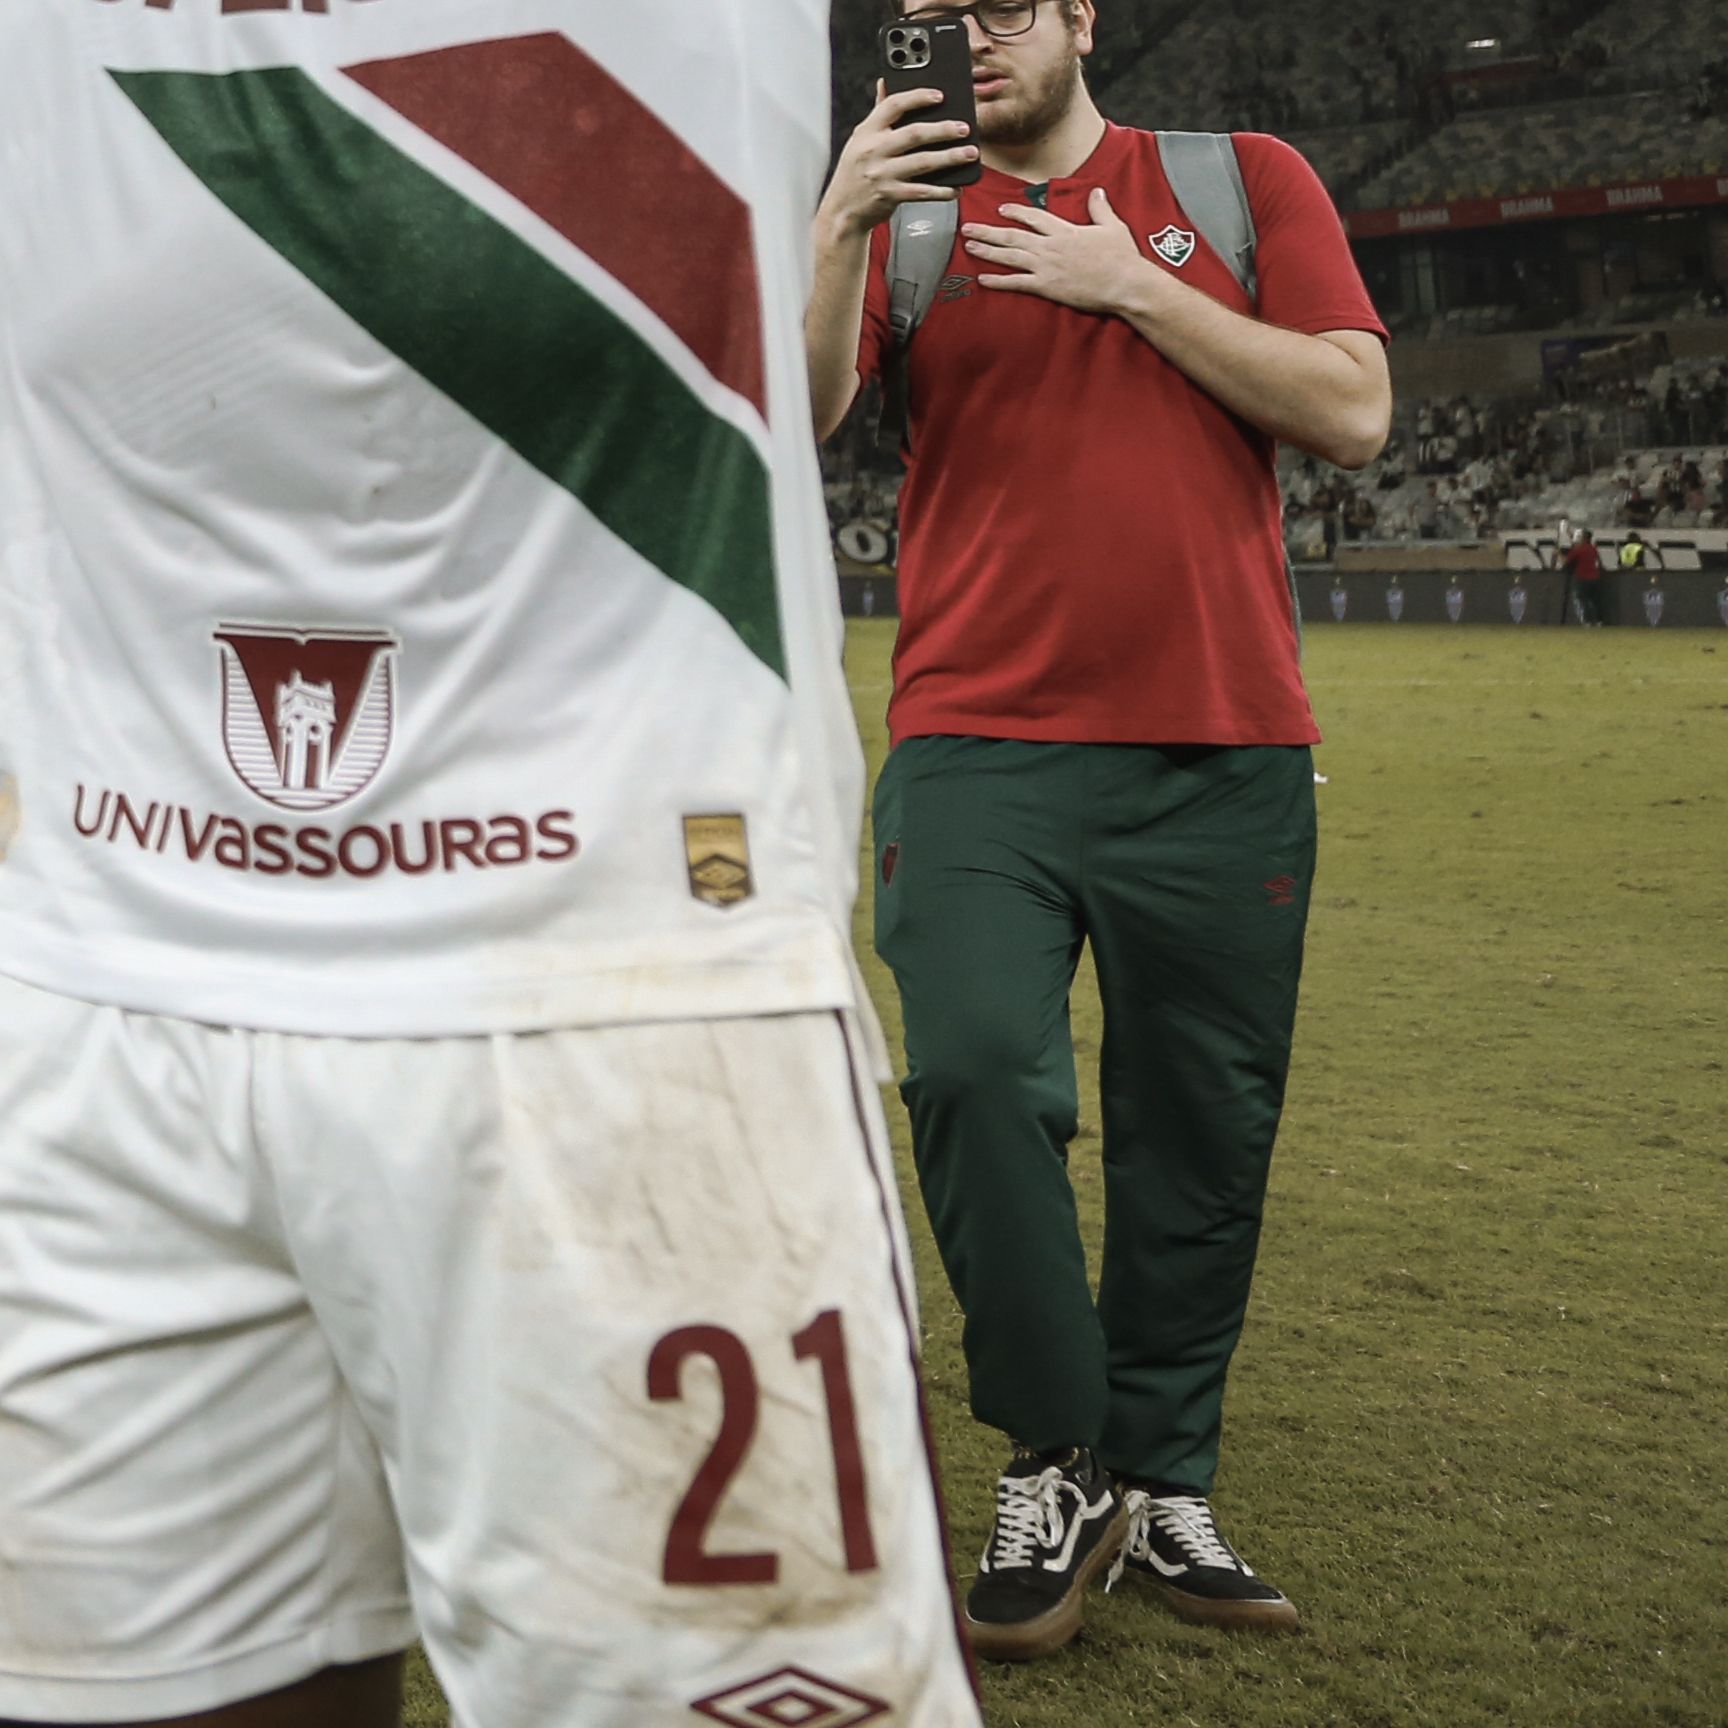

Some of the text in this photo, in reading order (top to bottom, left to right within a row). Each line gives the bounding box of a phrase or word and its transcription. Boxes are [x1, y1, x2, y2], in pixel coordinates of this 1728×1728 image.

[1500, 196, 1554, 218] BRAHMA
[1606, 185, 1663, 207] BRAHMA
[1398, 208, 1450, 229] BRAHMA
[646, 1307, 881, 1587] 21
